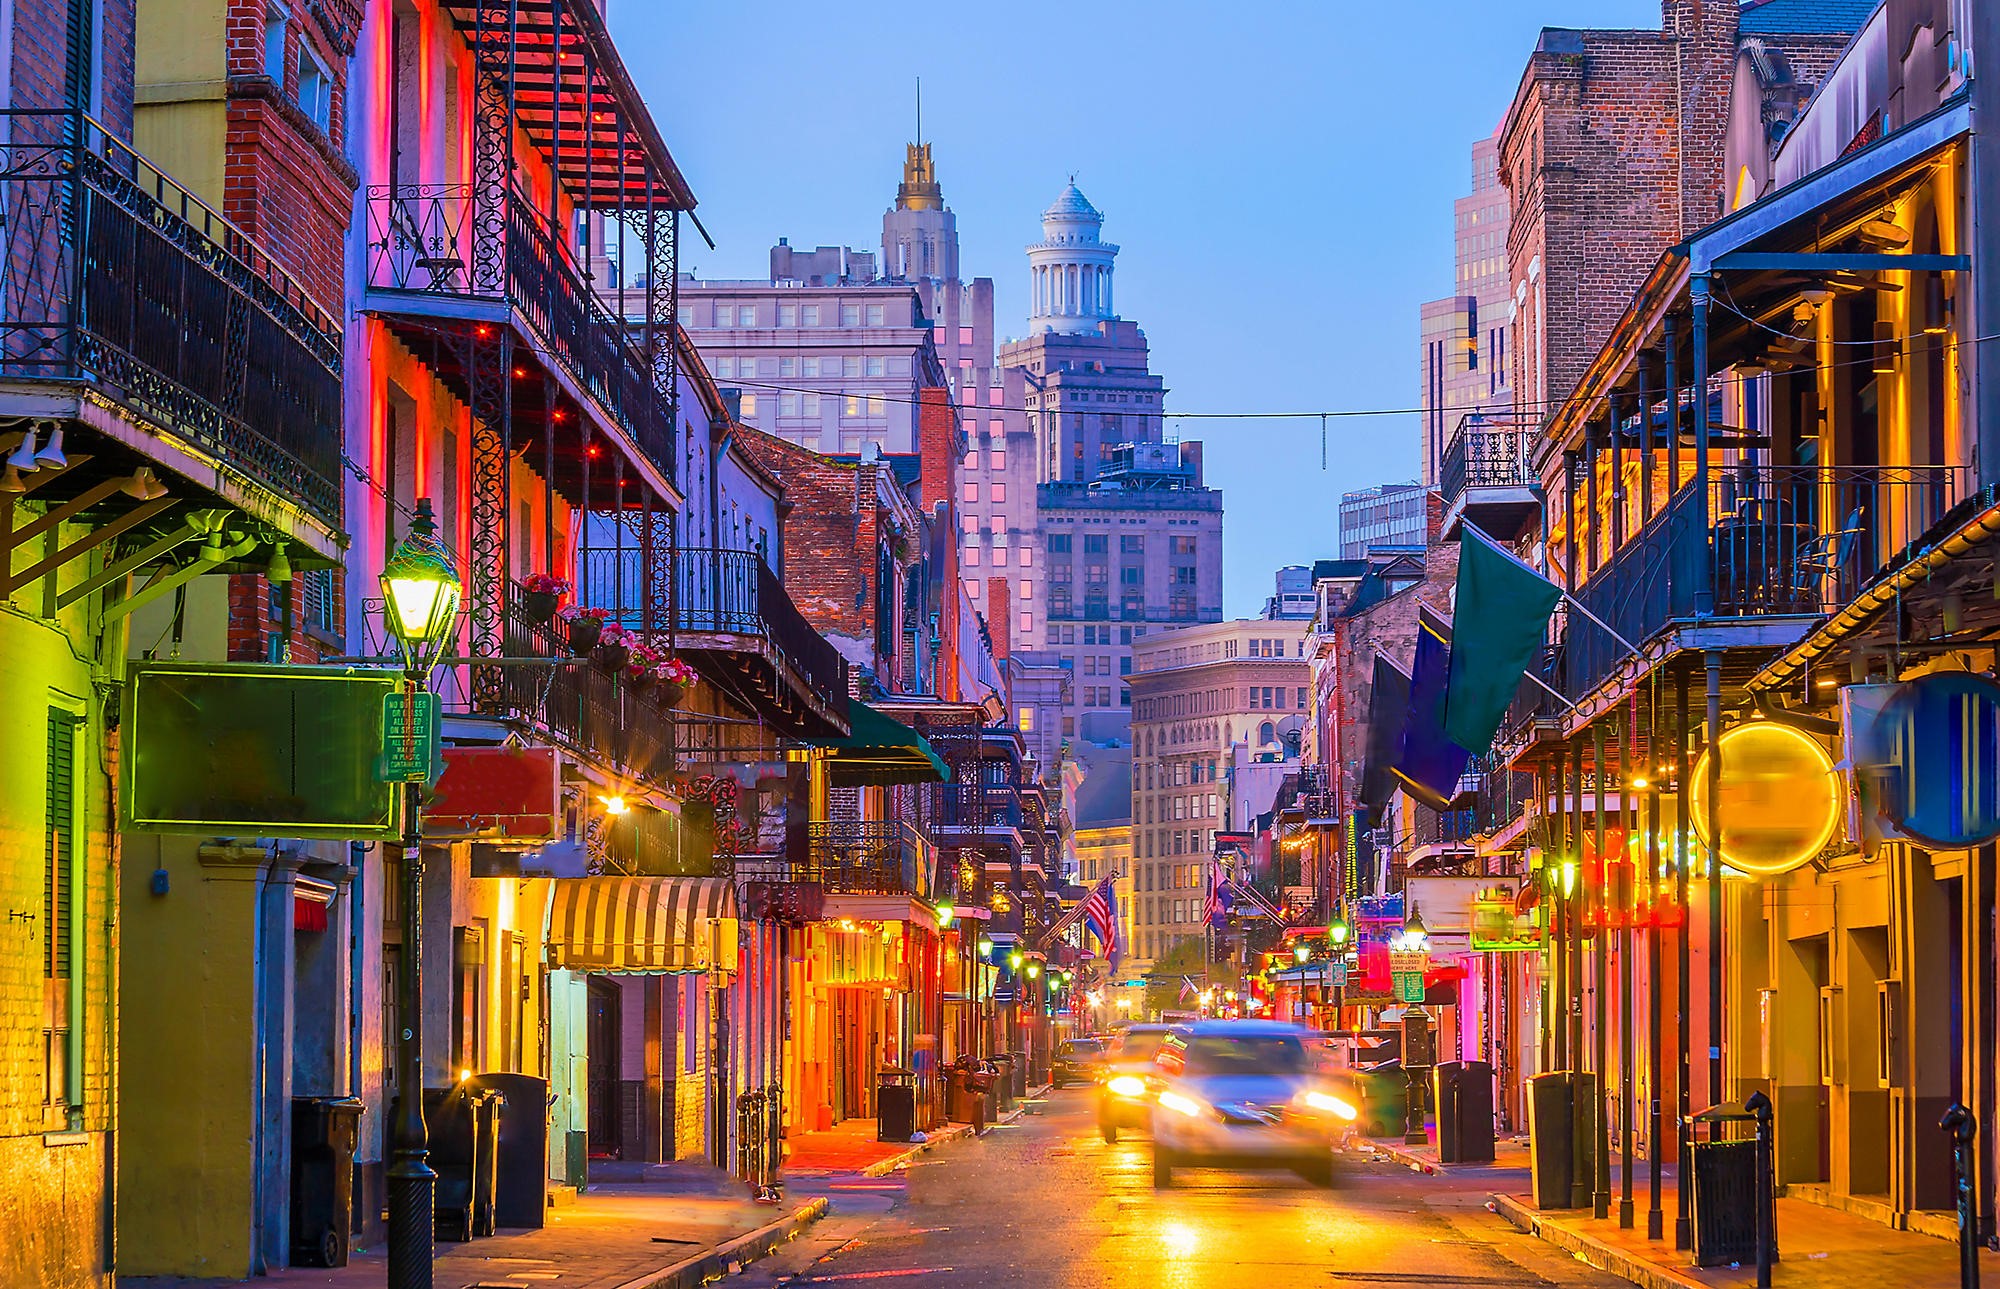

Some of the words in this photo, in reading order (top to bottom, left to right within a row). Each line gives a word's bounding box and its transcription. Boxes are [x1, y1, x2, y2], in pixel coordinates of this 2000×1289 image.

[389, 701, 398, 709] NO
[392, 709, 401, 717] OR
[390, 726, 399, 734] ON
